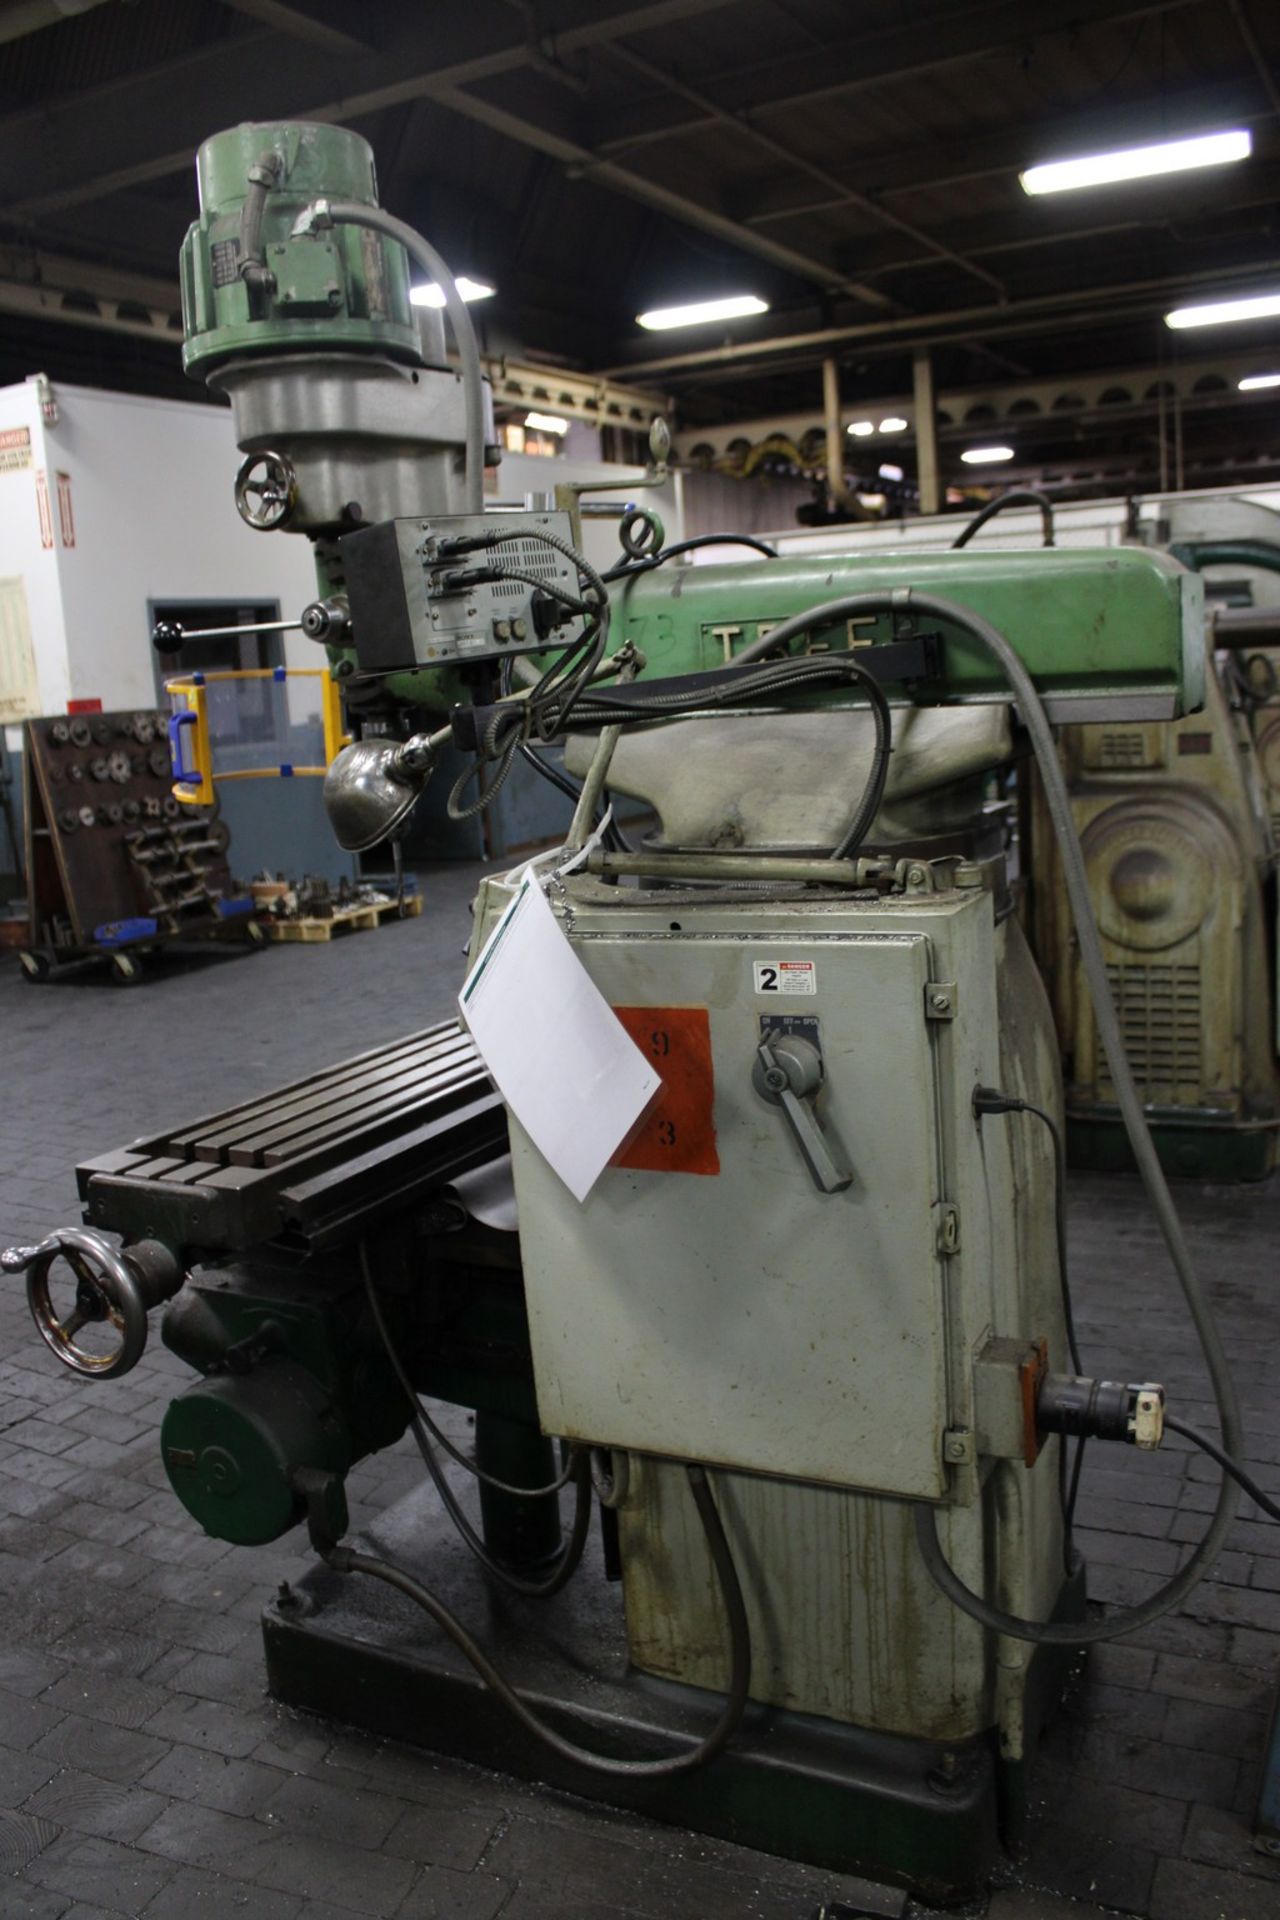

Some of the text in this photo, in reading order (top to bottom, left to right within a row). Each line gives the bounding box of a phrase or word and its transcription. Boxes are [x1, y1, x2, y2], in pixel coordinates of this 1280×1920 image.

[760, 968, 778, 991] 2
[652, 1031, 669, 1057] 9
[659, 1120, 676, 1146] 3
